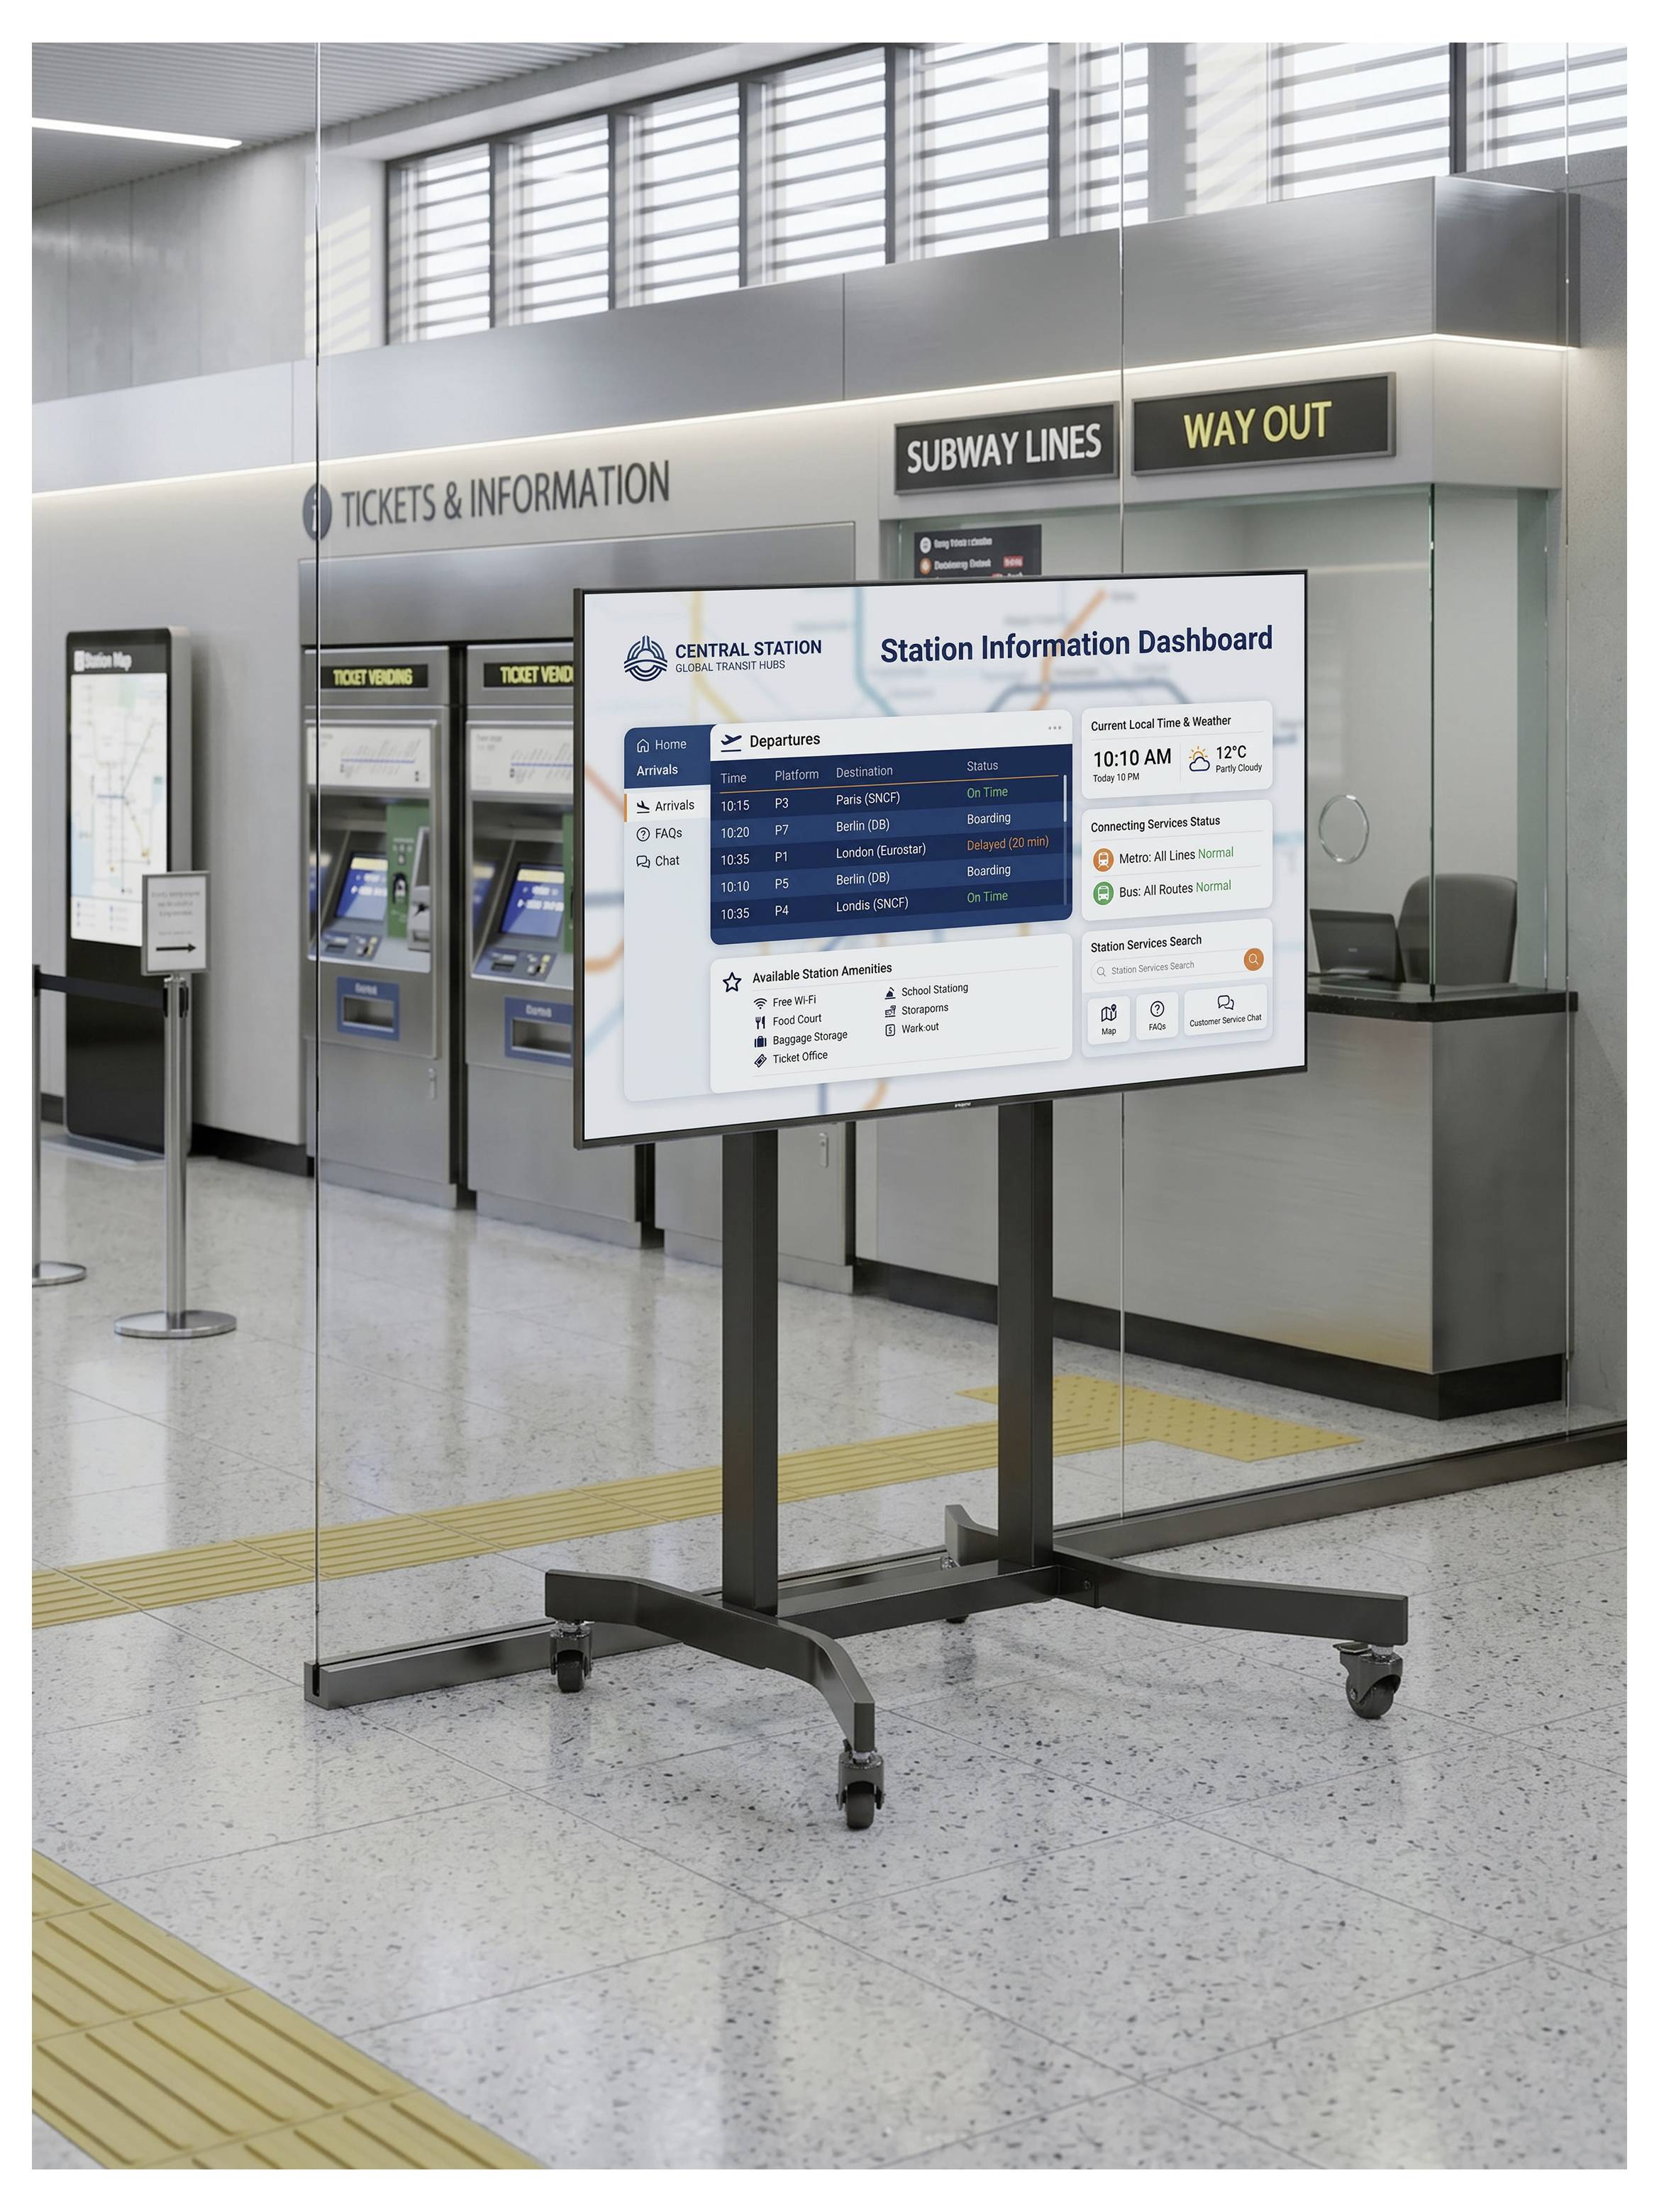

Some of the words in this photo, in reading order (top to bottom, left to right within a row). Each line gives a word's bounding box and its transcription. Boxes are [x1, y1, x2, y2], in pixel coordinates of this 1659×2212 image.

[1183, 408, 1256, 449] WAY
[1263, 401, 1332, 443] OUT
[907, 431, 1019, 474] SUBWAY
[1026, 423, 1102, 463] LINES
[341, 483, 436, 528] TICKETS
[444, 482, 462, 520] &
[471, 460, 670, 518] INFORMATION
[675, 642, 750, 659] CENTRAL
[753, 639, 821, 656] STATION
[880, 635, 973, 663] Station
[982, 630, 1130, 660] Information
[1138, 624, 1272, 654] Dashboard
[675, 662, 714, 673] GLOBAL
[716, 660, 757, 672] TRANSIT
[759, 660, 785, 669] HUBS
[333, 669, 367, 685] TICKET
[369, 668, 413, 685] VENDING
[500, 667, 539, 684] TICKET
[1091, 721, 1127, 732] Current
[1129, 718, 1155, 730] Local
[1157, 718, 1181, 728] Time
[1183, 716, 1190, 728] &
[1192, 715, 1232, 727] Weather
[655, 739, 687, 750] Home
[750, 734, 821, 750] Departures
[1094, 749, 1139, 767] 10:10
[1143, 747, 1171, 765] AM
[1216, 745, 1247, 760] 12°C
[636, 764, 678, 777] Arrivals
[720, 772, 747, 784] Time
[775, 769, 819, 782] Platform
[836, 766, 893, 778] Destination
[967, 760, 999, 772] Status
[1216, 764, 1237, 774] Partly
[1238, 762, 1263, 773] Cloudy
[1092, 774, 1115, 784] Today
[1116, 772, 1126, 782] 10
[1127, 772, 1140, 781] PM
[655, 799, 695, 812] Arrivals
[721, 799, 750, 812] 10:15
[775, 797, 789, 809] P3
[836, 794, 862, 806] Paris
[865, 791, 900, 806] (SNCF)
[967, 787, 981, 799] On
[983, 787, 1009, 798] Time
[721, 826, 750, 838] 10:20
[775, 824, 789, 835] P7
[836, 820, 865, 832] Berlin
[867, 818, 890, 833] (DB)
[967, 812, 1011, 826] Boarding
[1091, 821, 1145, 833] Connecting
[1148, 818, 1188, 830] Services
[1190, 816, 1221, 827] Status
[655, 827, 682, 840] FAQs
[721, 853, 750, 865] 10:35
[775, 851, 787, 862] P1
[836, 846, 874, 859] London
[877, 842, 926, 859] (Eurostar)
[967, 838, 1006, 852] Delayed
[1009, 836, 1025, 851] (20
[1027, 835, 1049, 848] min)
[1119, 852, 1151, 864] Metro:
[1153, 850, 1167, 862] All
[1170, 850, 1196, 861] Lines
[1198, 846, 1233, 859] Normal
[655, 855, 680, 867] Chat
[721, 880, 750, 893] 10:10
[775, 878, 789, 889] P5
[836, 873, 865, 886] Berlin
[867, 871, 890, 886] (DB)
[967, 864, 1011, 877] Boarding
[1119, 887, 1141, 897] Bus:
[1143, 884, 1156, 896] All
[1159, 884, 1194, 895] Routes
[1196, 879, 1231, 893] Normal
[721, 907, 750, 920] 10:35
[775, 904, 789, 916] P4
[836, 899, 870, 912] Londis
[873, 896, 909, 912] (SNCF)
[967, 892, 981, 904] On
[983, 891, 1009, 902] Time
[1091, 941, 1125, 953] Station
[1127, 938, 1167, 950] Services
[1170, 934, 1202, 947] Search
[752, 969, 800, 984] Available
[802, 968, 838, 979] Station
[841, 962, 892, 977] Amenities
[1111, 967, 1137, 975] Station
[1138, 964, 1169, 973] Services
[1170, 960, 1194, 970] Search
[901, 984, 931, 997] School
[933, 984, 968, 994] Stationg
[773, 997, 792, 1007] Free
[794, 994, 816, 1006] Wi-Fi
[773, 1015, 795, 1026] Food
[797, 1013, 822, 1024] Court
[1148, 1023, 1166, 1031] FAQs
[1189, 1018, 1221, 1028] Customer
[1247, 1013, 1262, 1022] Chat
[773, 1034, 812, 1046] Baggage
[814, 1031, 848, 1042] Storage
[1102, 1028, 1116, 1036] Map
[772, 1052, 800, 1064] Ticket
[801, 1050, 828, 1062] Office
